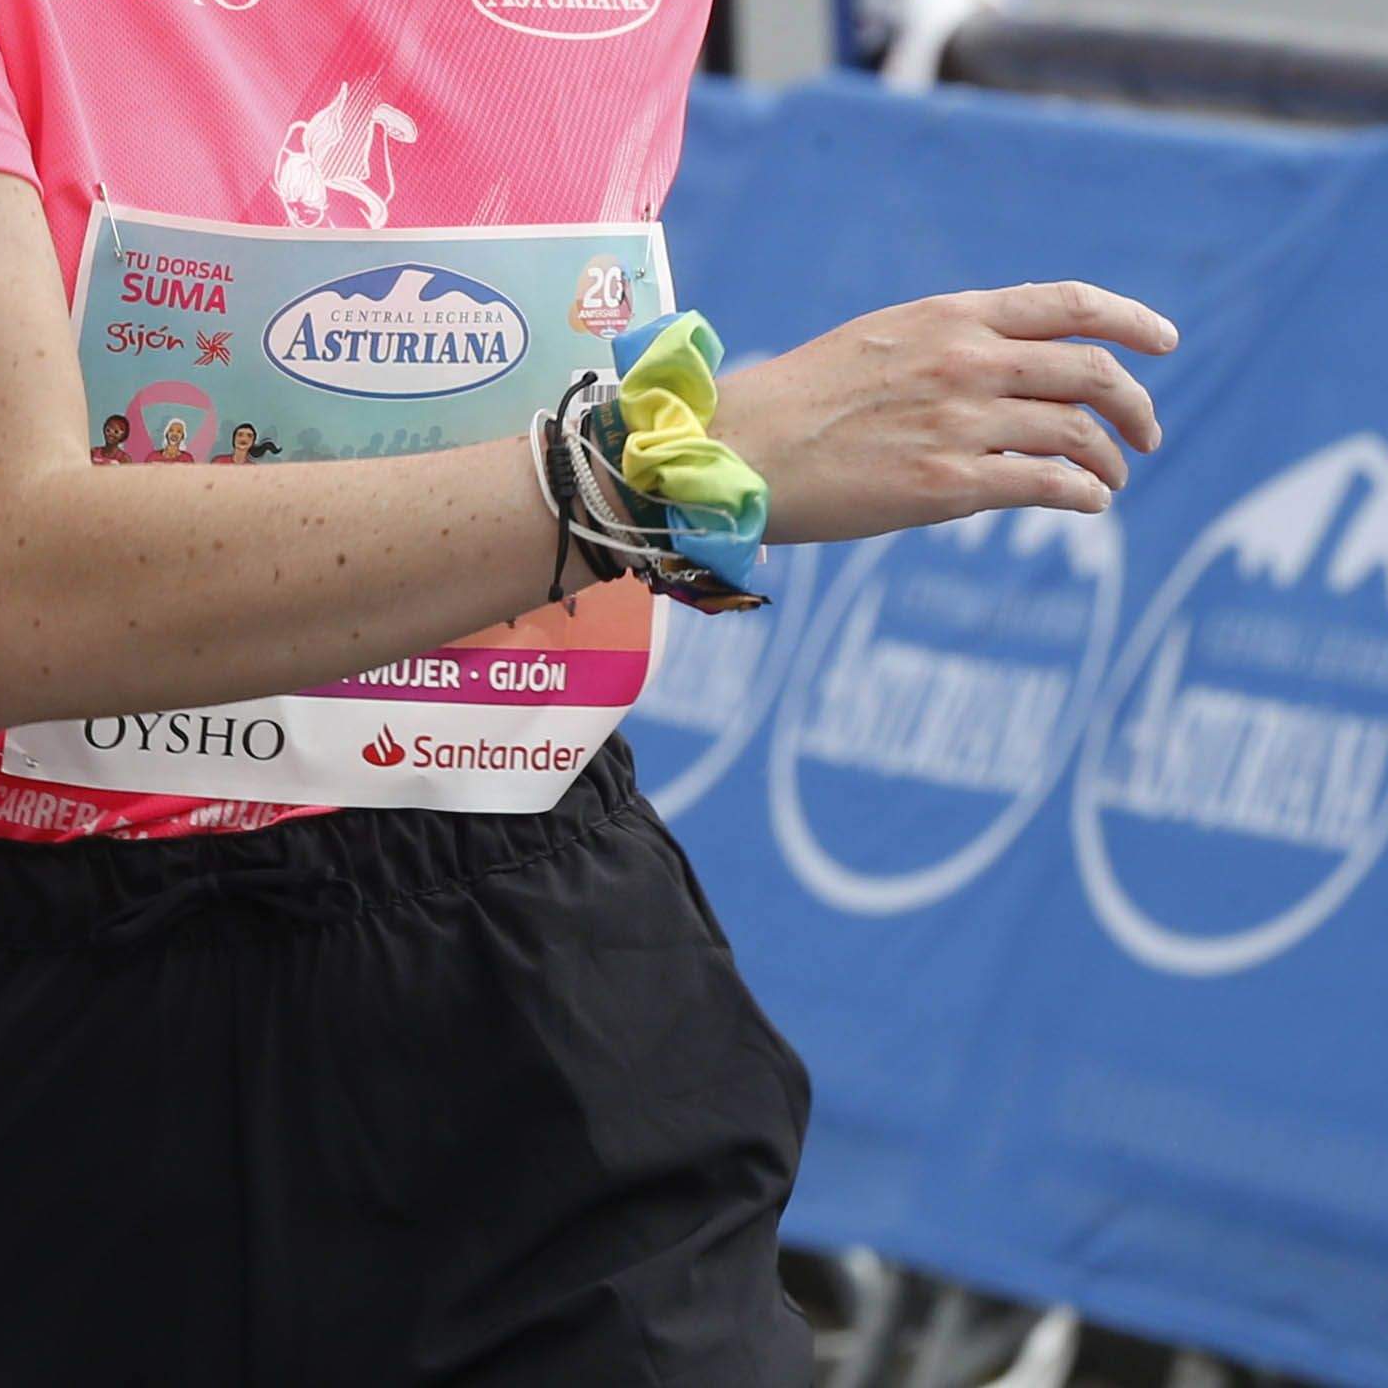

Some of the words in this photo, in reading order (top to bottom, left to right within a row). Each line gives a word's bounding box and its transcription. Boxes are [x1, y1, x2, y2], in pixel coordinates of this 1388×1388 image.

[125, 251, 151, 270] TU
[156, 255, 235, 283] DORSAL
[120, 272, 227, 315] SUMA
[331, 310, 415, 324] CENTRAL
[423, 311, 505, 325] LECHERA
[282, 312, 509, 364] ASTURIANA
[488, 653, 567, 693] GIJÓN
[84, 712, 286, 761] OYSHO
[412, 736, 586, 772] Santander
